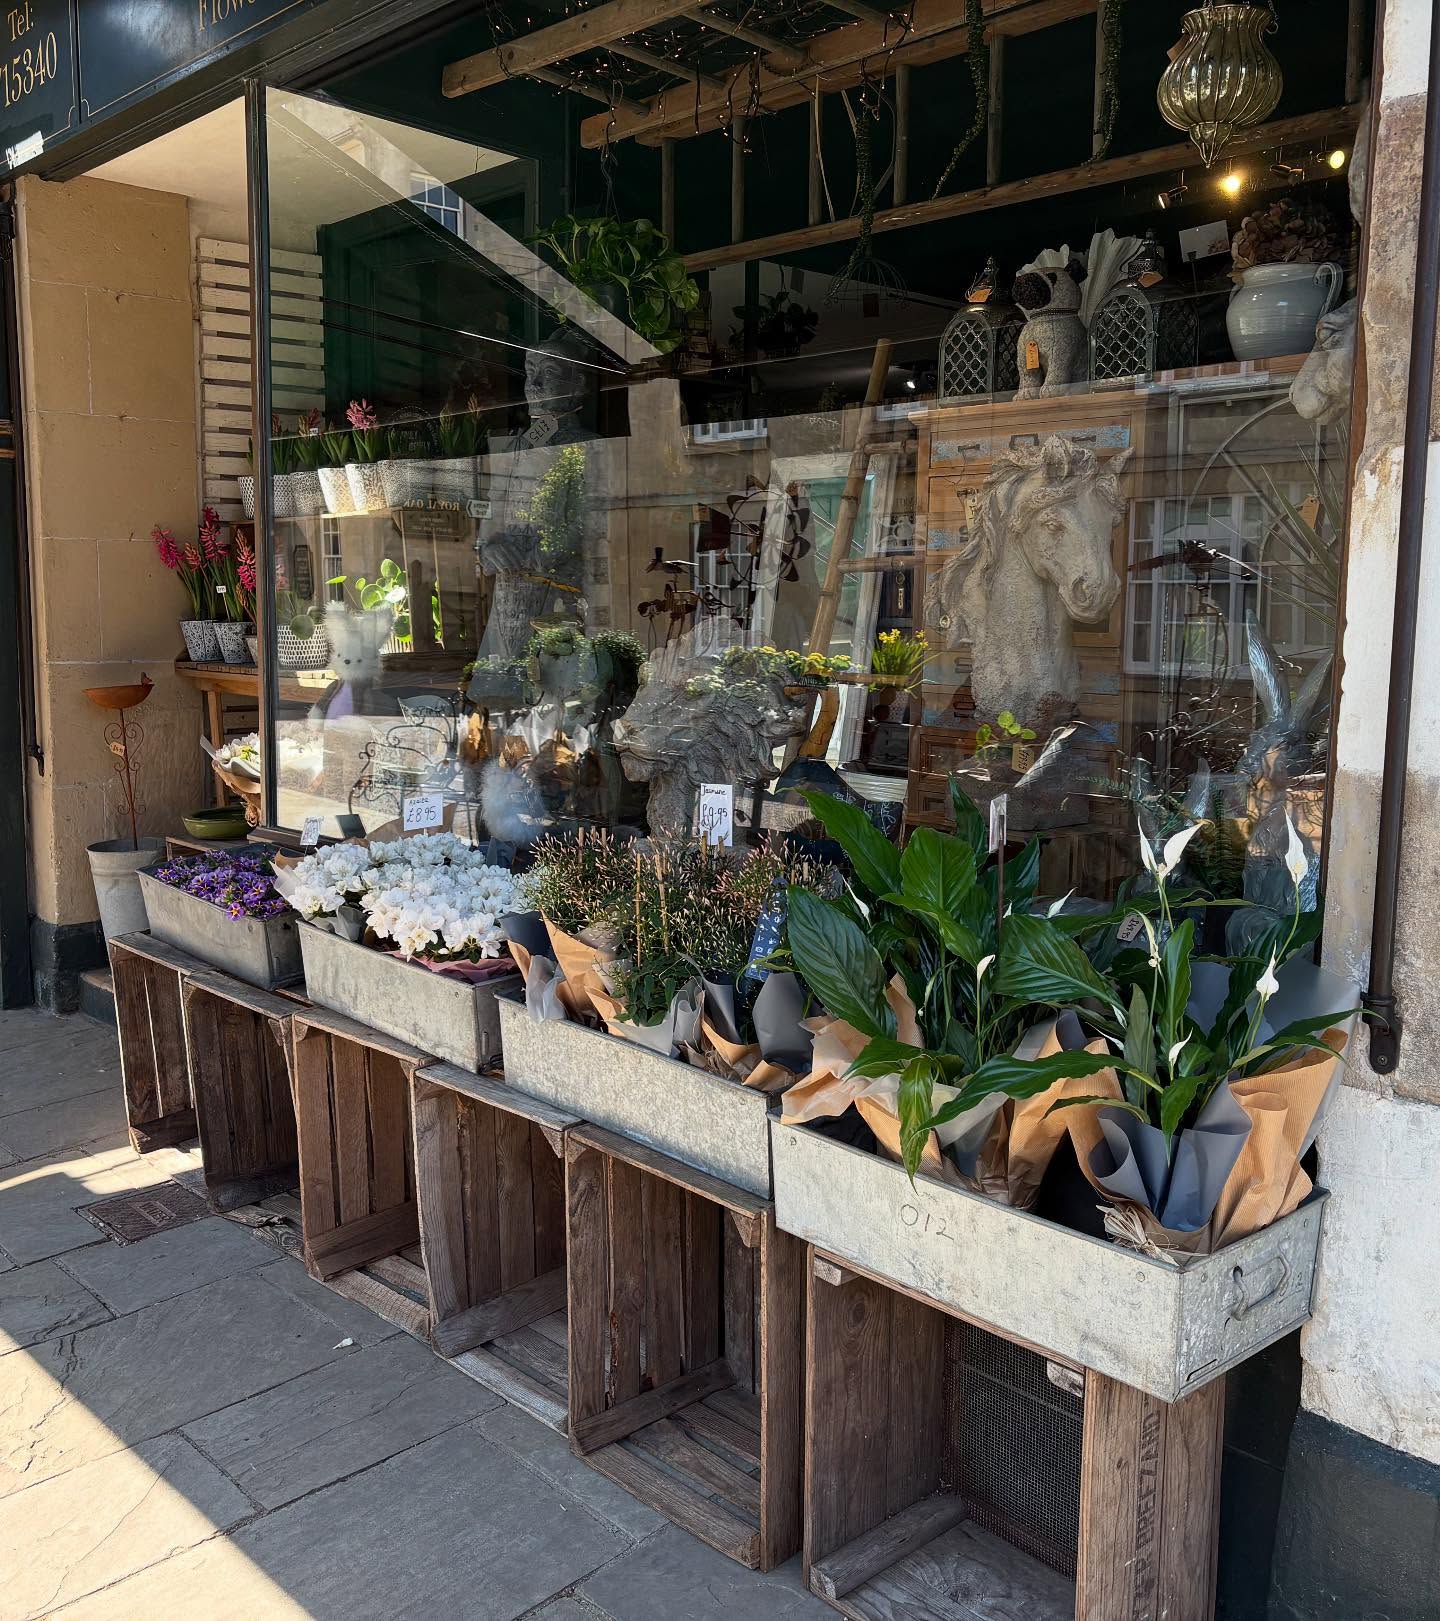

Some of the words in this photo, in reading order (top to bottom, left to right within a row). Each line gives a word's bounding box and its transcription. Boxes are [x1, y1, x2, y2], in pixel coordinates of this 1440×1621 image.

[8, 0, 34, 41] Tel:
[199, 0, 255, 32] Flo
[0, 32, 57, 107] 15340
